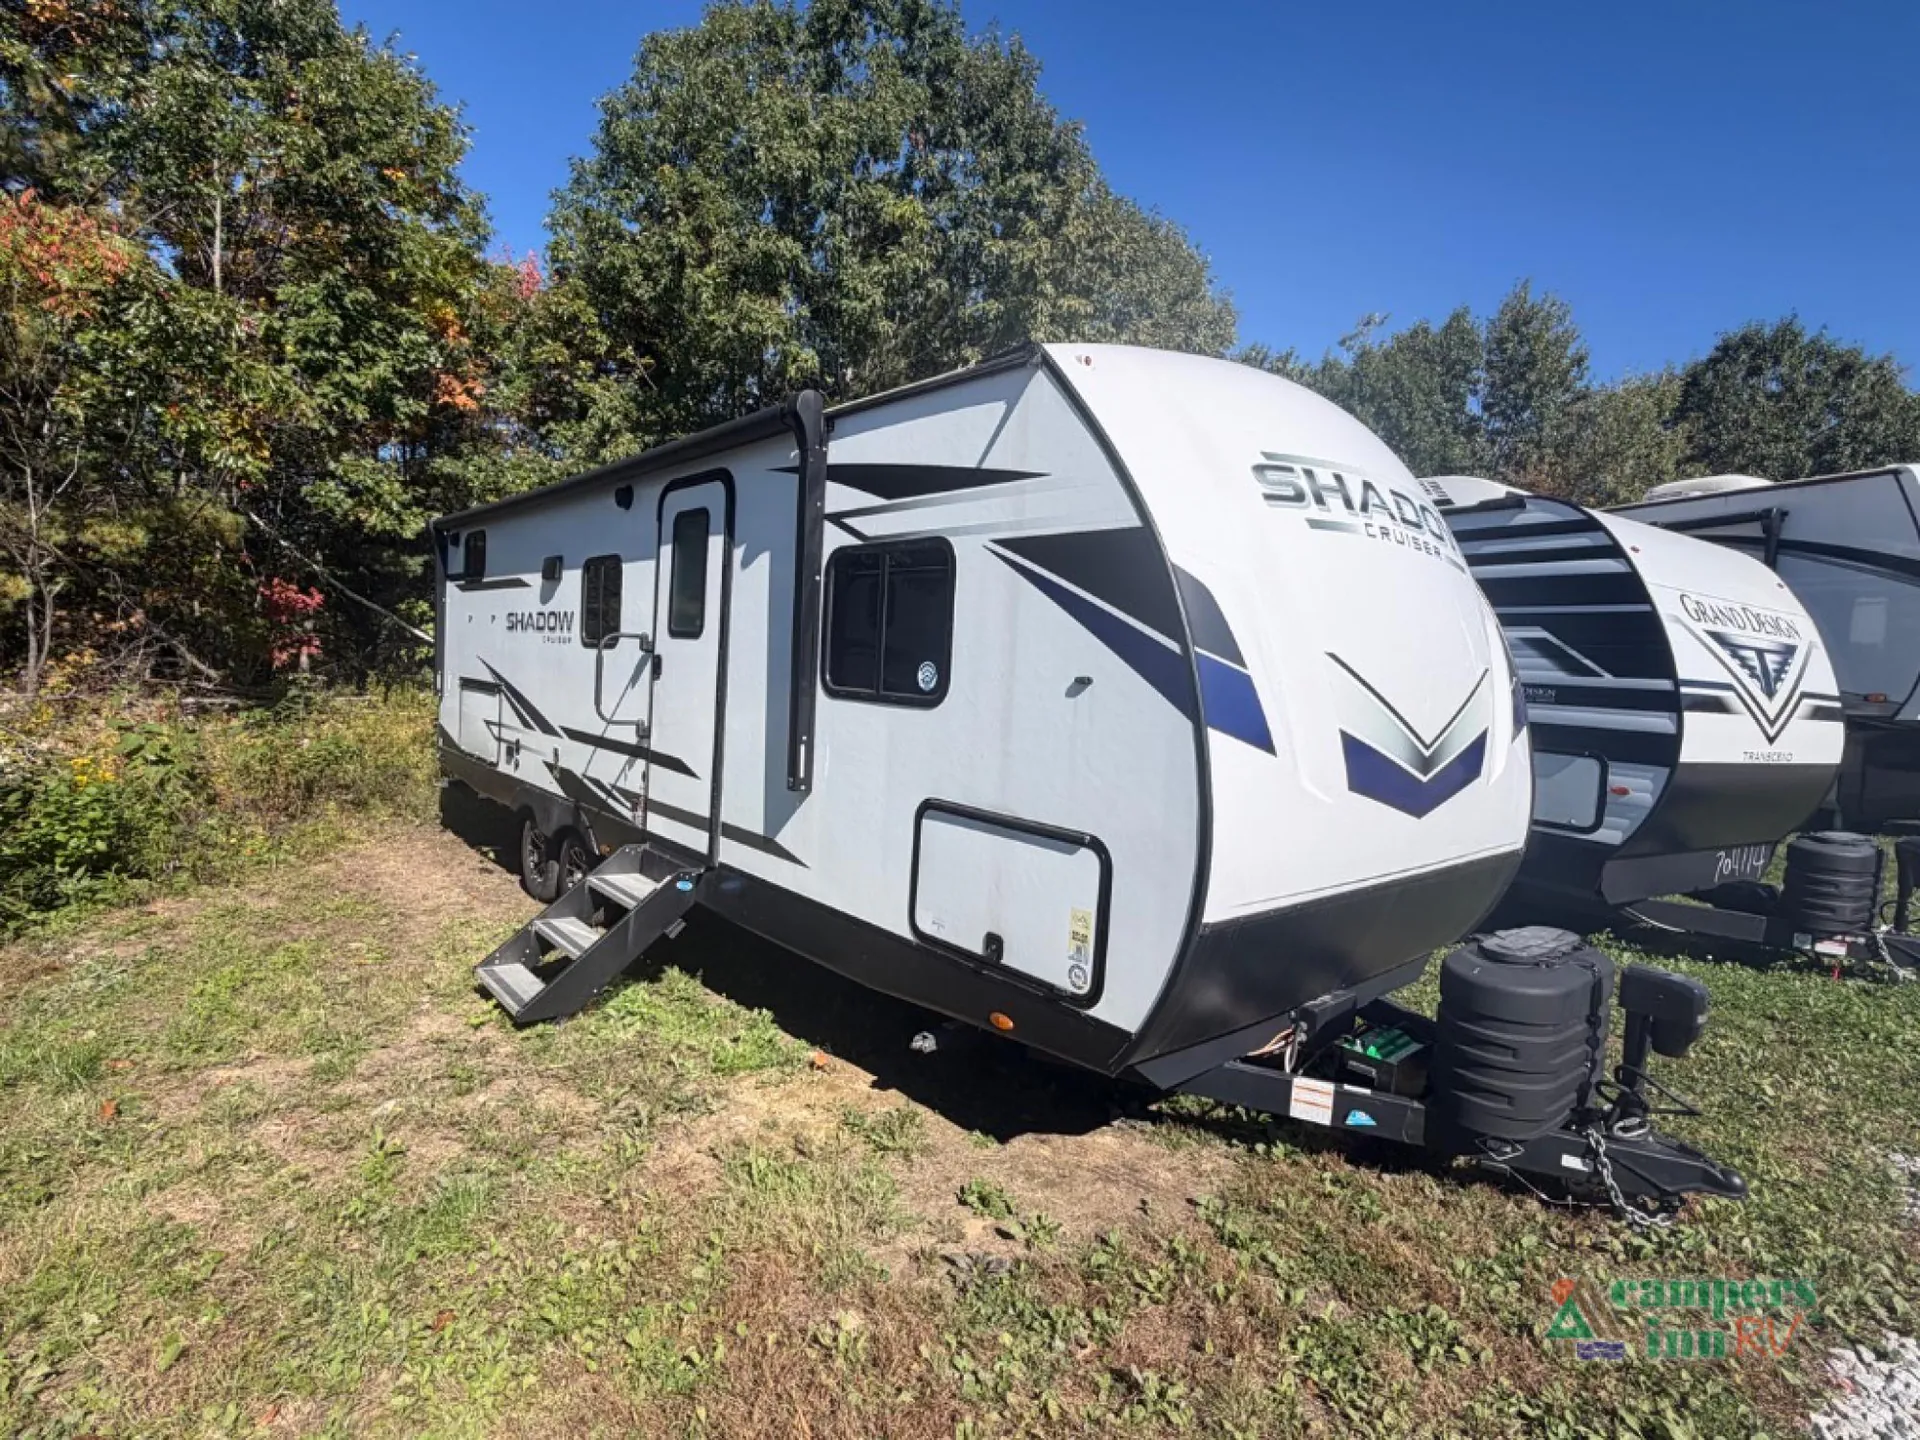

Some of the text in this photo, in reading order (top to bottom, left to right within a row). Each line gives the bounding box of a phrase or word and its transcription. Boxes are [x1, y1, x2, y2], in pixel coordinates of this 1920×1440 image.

[1364, 522, 1443, 561] CRUISER
[505, 610, 575, 633] SHADOW
[1679, 593, 1803, 640] GRAND DESIGN
